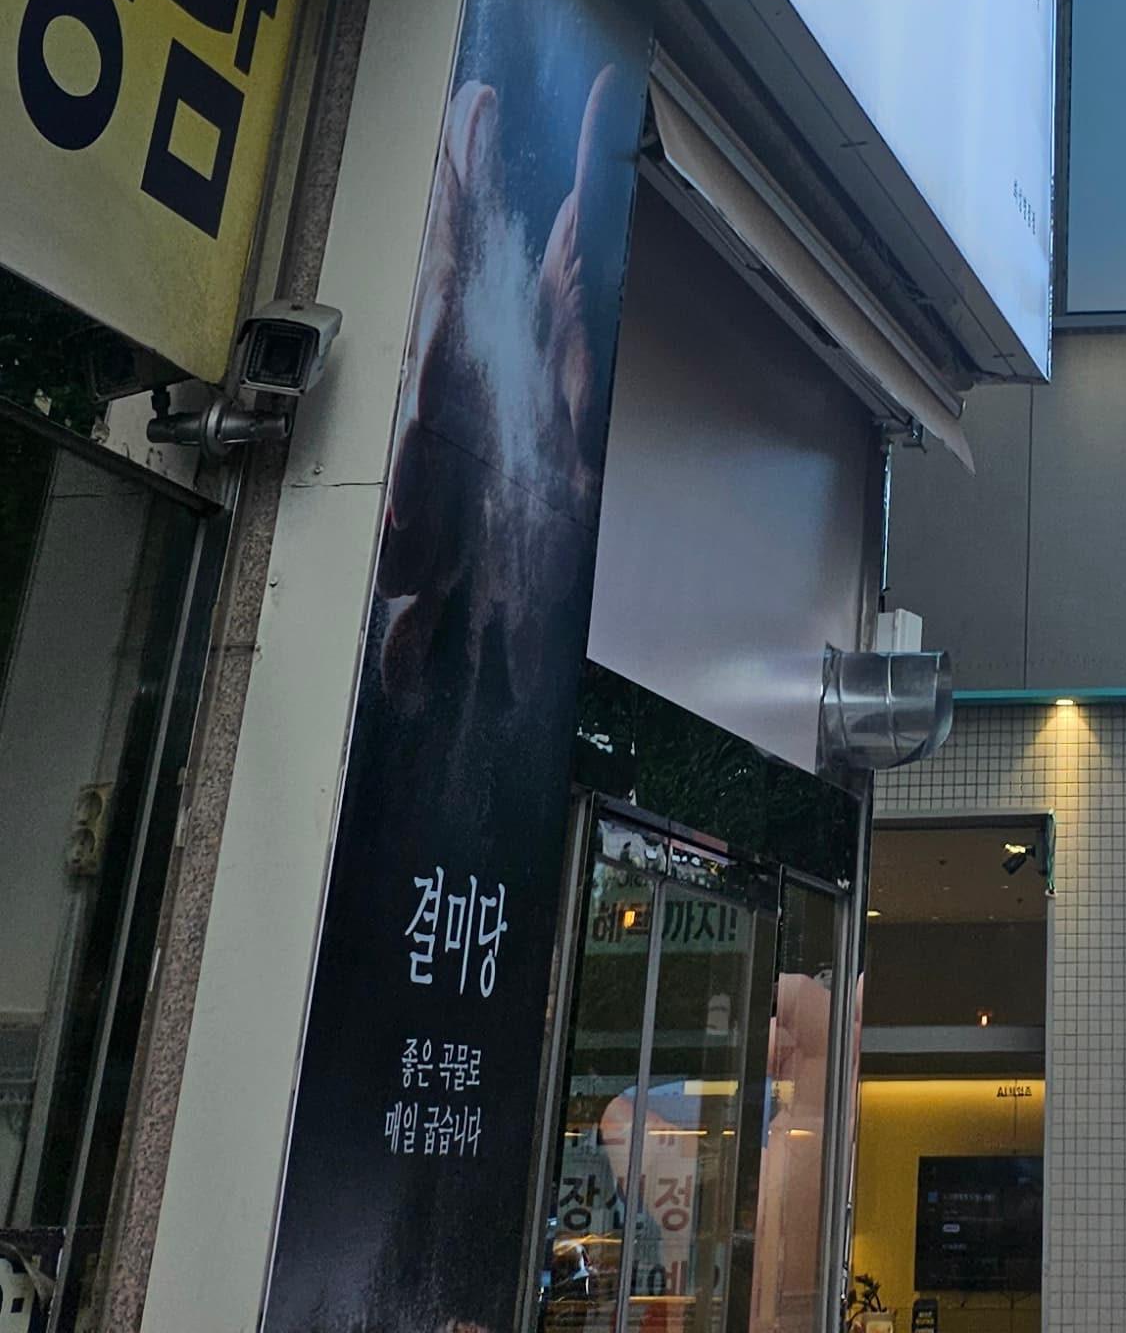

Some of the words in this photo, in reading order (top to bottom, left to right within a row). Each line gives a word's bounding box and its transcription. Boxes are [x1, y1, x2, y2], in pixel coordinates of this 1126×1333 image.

[405, 866, 508, 998] 결미당
[400, 1037, 433, 1088] 좋은
[438, 1041, 482, 1088] 곡물로
[383, 1101, 418, 1155] 매일
[422, 1106, 483, 1156] 굽습니다
